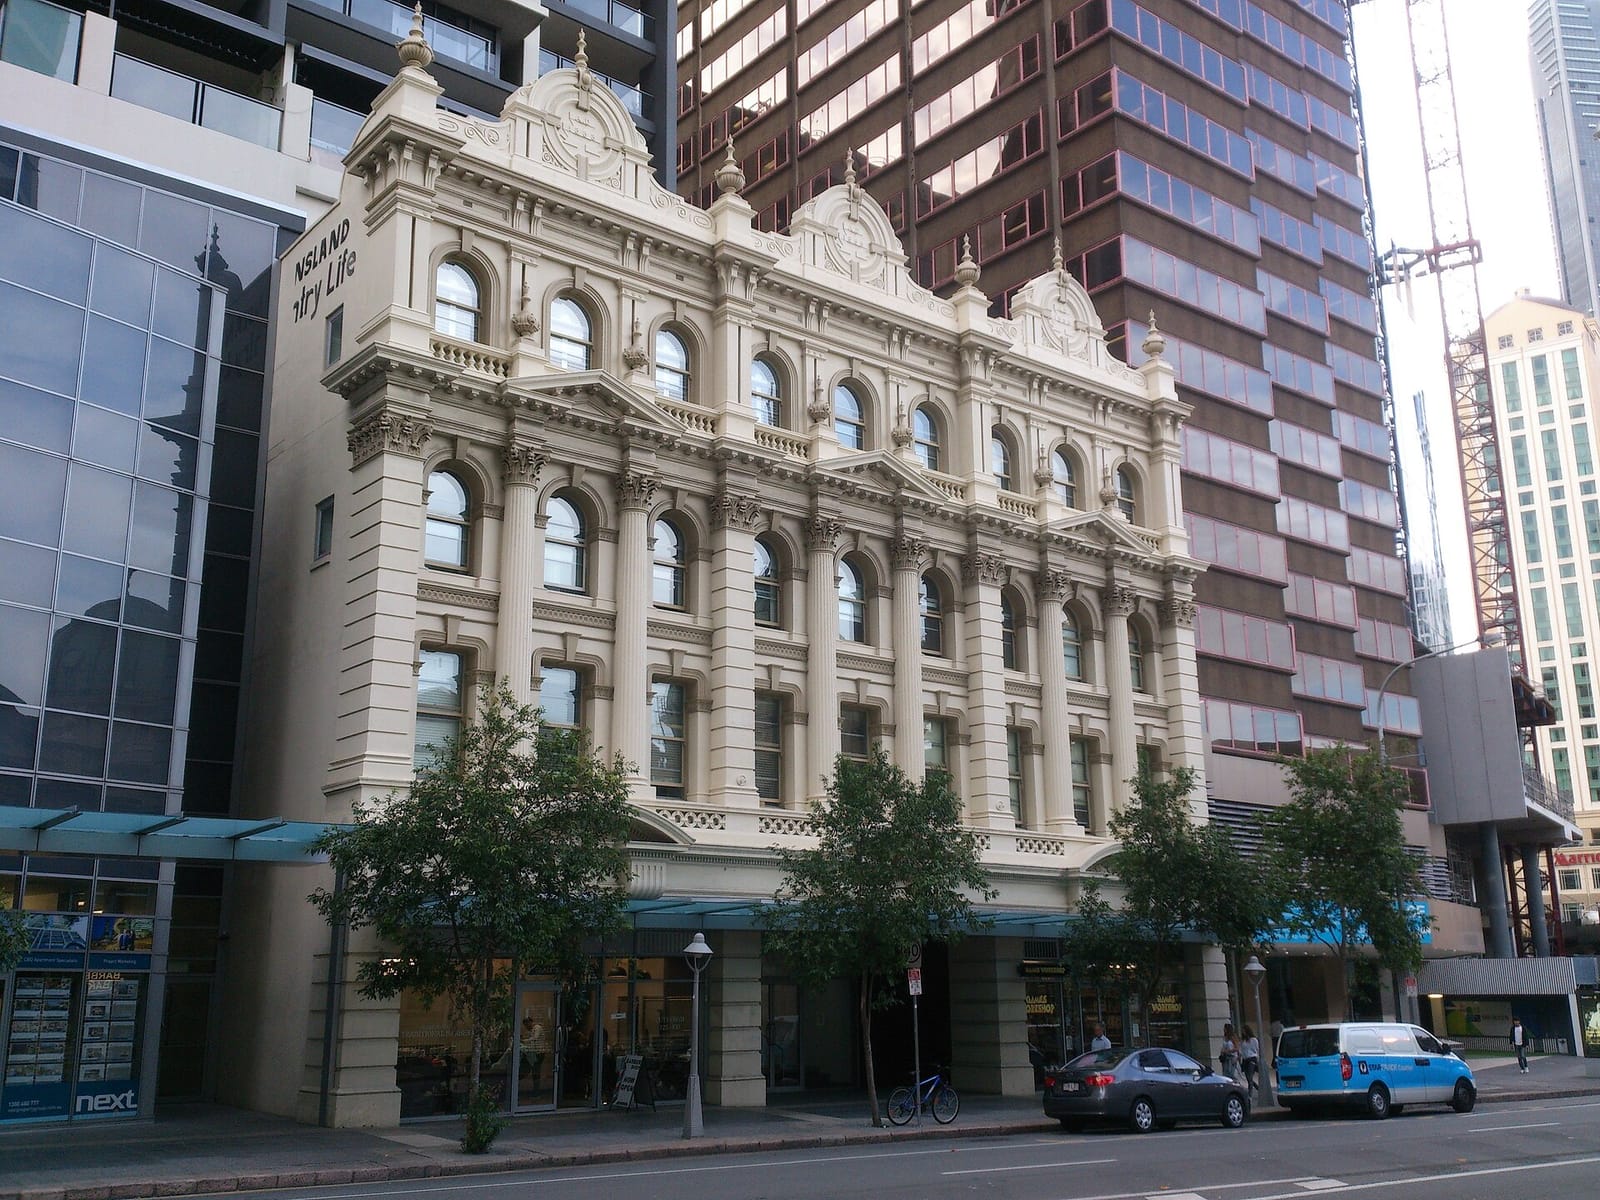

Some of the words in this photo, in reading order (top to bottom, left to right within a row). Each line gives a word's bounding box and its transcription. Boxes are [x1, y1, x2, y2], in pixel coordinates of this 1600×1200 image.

[295, 218, 350, 286] NSLAND
[326, 248, 357, 297] Life
[1025, 1003, 1056, 1015] ORKSHOP
[75, 1089, 138, 1112] next
